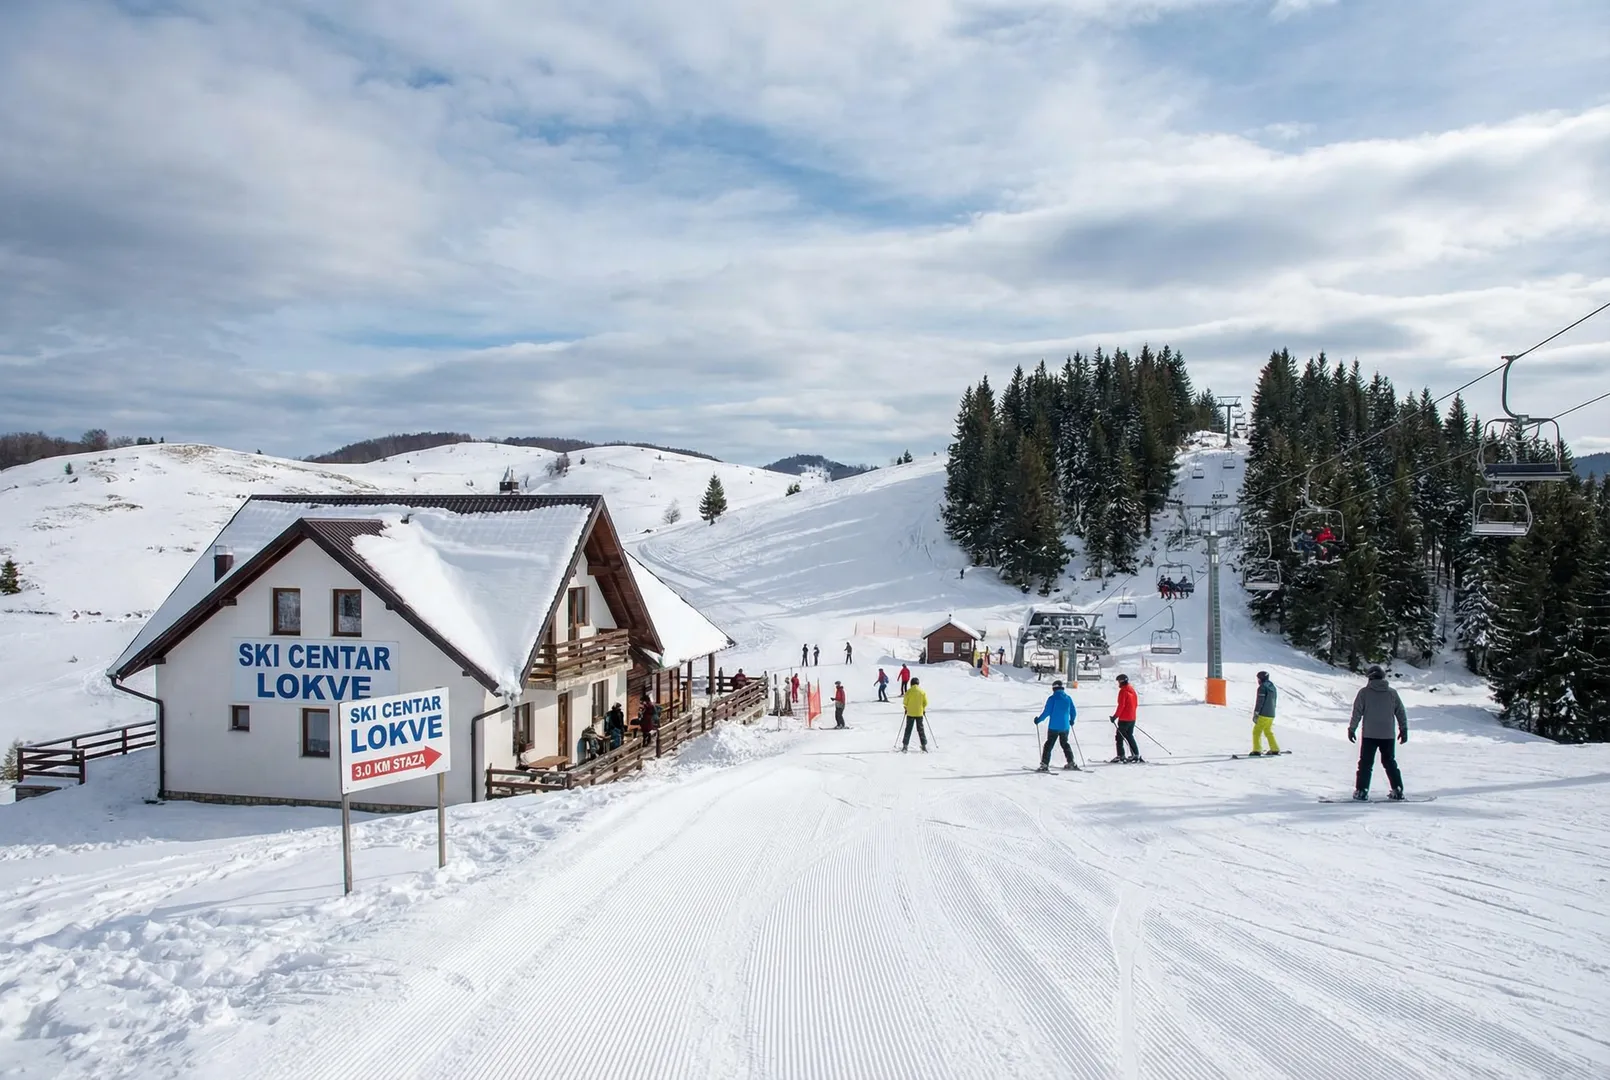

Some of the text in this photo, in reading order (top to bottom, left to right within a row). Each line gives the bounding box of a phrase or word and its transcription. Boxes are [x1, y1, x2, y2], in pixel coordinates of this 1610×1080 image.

[238, 642, 391, 671] SKI CENTAR
[257, 673, 372, 700] LOKVE
[350, 695, 442, 724] SKI CENTAR
[351, 714, 443, 753] LOKVE
[374, 761, 391, 774] KM
[393, 753, 426, 770] STAZA
